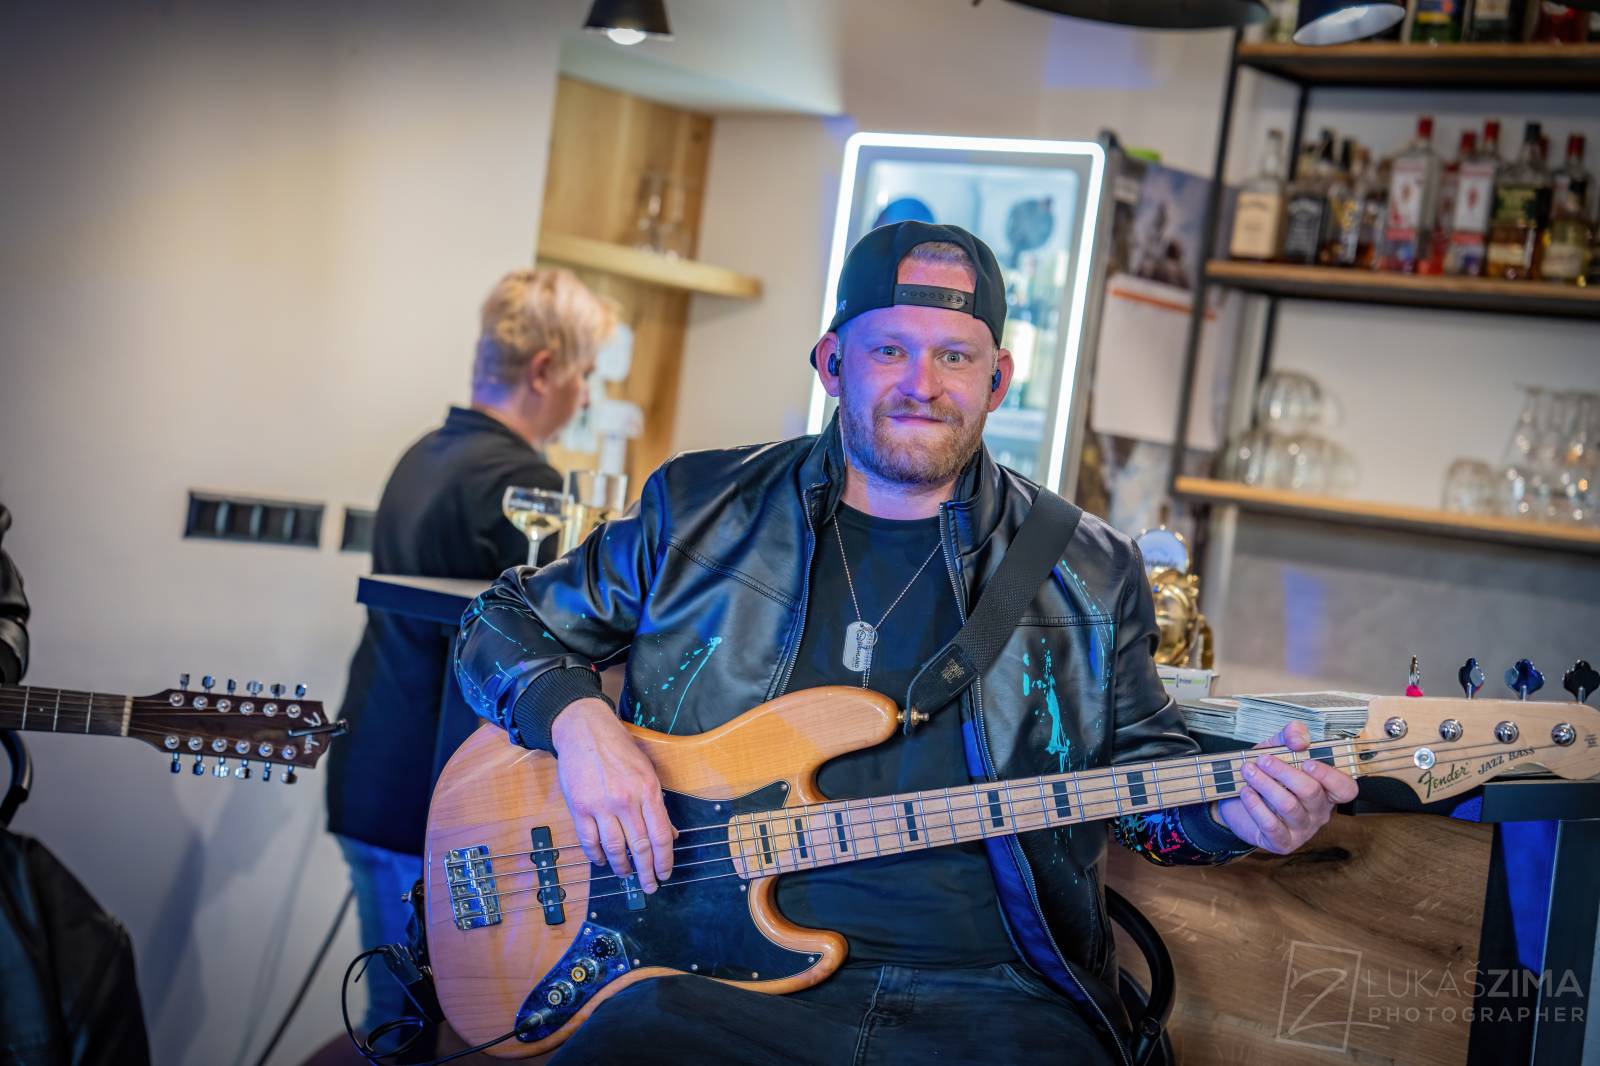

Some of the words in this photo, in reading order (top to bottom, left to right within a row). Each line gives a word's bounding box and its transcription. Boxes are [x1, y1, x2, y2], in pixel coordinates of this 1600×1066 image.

[1478, 755, 1505, 774] JAZZ
[1508, 748, 1535, 761] BASS
[1417, 763, 1469, 799] Fender
